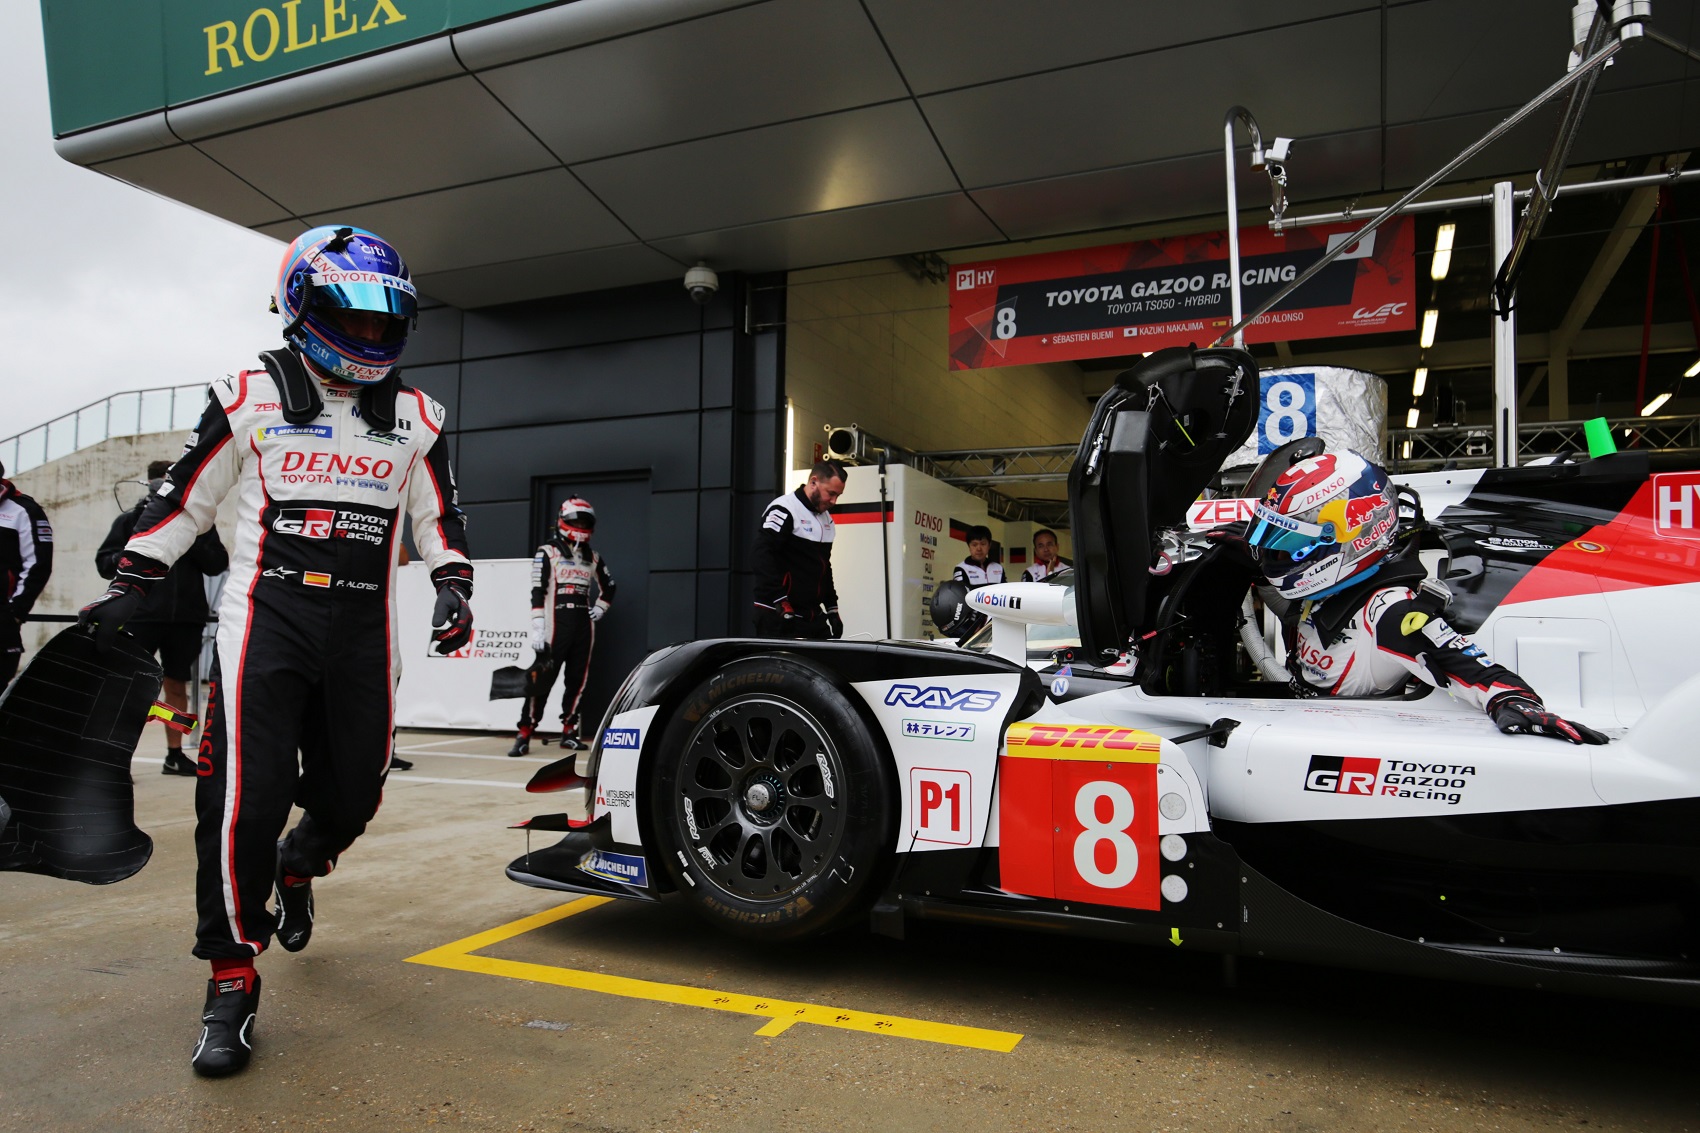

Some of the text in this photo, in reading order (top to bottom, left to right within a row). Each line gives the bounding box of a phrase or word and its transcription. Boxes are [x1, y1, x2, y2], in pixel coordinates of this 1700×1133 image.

[203, 0, 407, 76] ROLEX
[361, 243, 386, 258] citi
[322, 272, 379, 284] TOYOTA
[958, 270, 995, 288] P1 HY
[1046, 284, 1123, 307] TOYOTA
[1131, 275, 1205, 298] GAZOO
[1107, 303, 1143, 316] TOYOTA
[1145, 299, 1175, 311] TS050
[1184, 293, 1221, 307] HYBRID
[1352, 302, 1408, 320] WEC
[996, 307, 1017, 339] 8
[1272, 312, 1304, 324] ALONSO
[1052, 330, 1114, 344] SÉBASTIEN BUEMI
[1139, 321, 1204, 336] KAZUKI NAKAJIMA
[346, 364, 388, 376] DENSO
[254, 402, 282, 413] ZEN
[1265, 381, 1308, 446] 8
[276, 427, 327, 436] MICHELIN
[281, 451, 393, 479] DENSO
[281, 474, 390, 492] TOYOTA HYBRID
[1306, 476, 1346, 505] DENSO
[1193, 500, 1260, 526] ZEN
[1659, 485, 1700, 529] H
[338, 510, 389, 528] TOYOTA
[914, 510, 943, 533] DENSO
[1256, 505, 1300, 532] HYBRID
[275, 519, 330, 538] GR
[334, 529, 384, 546] Racing
[920, 533, 932, 545] Mobil
[1502, 537, 1539, 545] ACTION
[921, 547, 935, 561] ZENT
[560, 568, 590, 579] DENSO
[1314, 556, 1339, 575] LEMO
[346, 580, 379, 591] ALONSO
[1286, 586, 1310, 597] RICHARD
[1296, 579, 1312, 587] BELL
[975, 591, 1007, 608] Mobil
[478, 630, 528, 639] TOYOTA
[476, 640, 522, 649] GAZOO
[474, 650, 520, 661] Racing
[707, 672, 785, 700] MICHELIN
[1054, 681, 1066, 693] N
[884, 684, 1001, 712] RAYS
[905, 722, 972, 738] 林テレンプ
[1024, 725, 1140, 751] DHL
[603, 732, 636, 746] AISIN
[1387, 760, 1477, 776] TOYOTA
[1306, 769, 1376, 795] GR
[1383, 773, 1466, 788] GAZOO
[606, 790, 635, 799] MITSUBISHI
[606, 798, 631, 808] ELECTRIC
[1380, 785, 1462, 805] Racing
[919, 780, 960, 832] P1
[1073, 780, 1139, 889] 8
[595, 858, 639, 877] MICHELIN
[704, 896, 781, 923] MICHELIN
